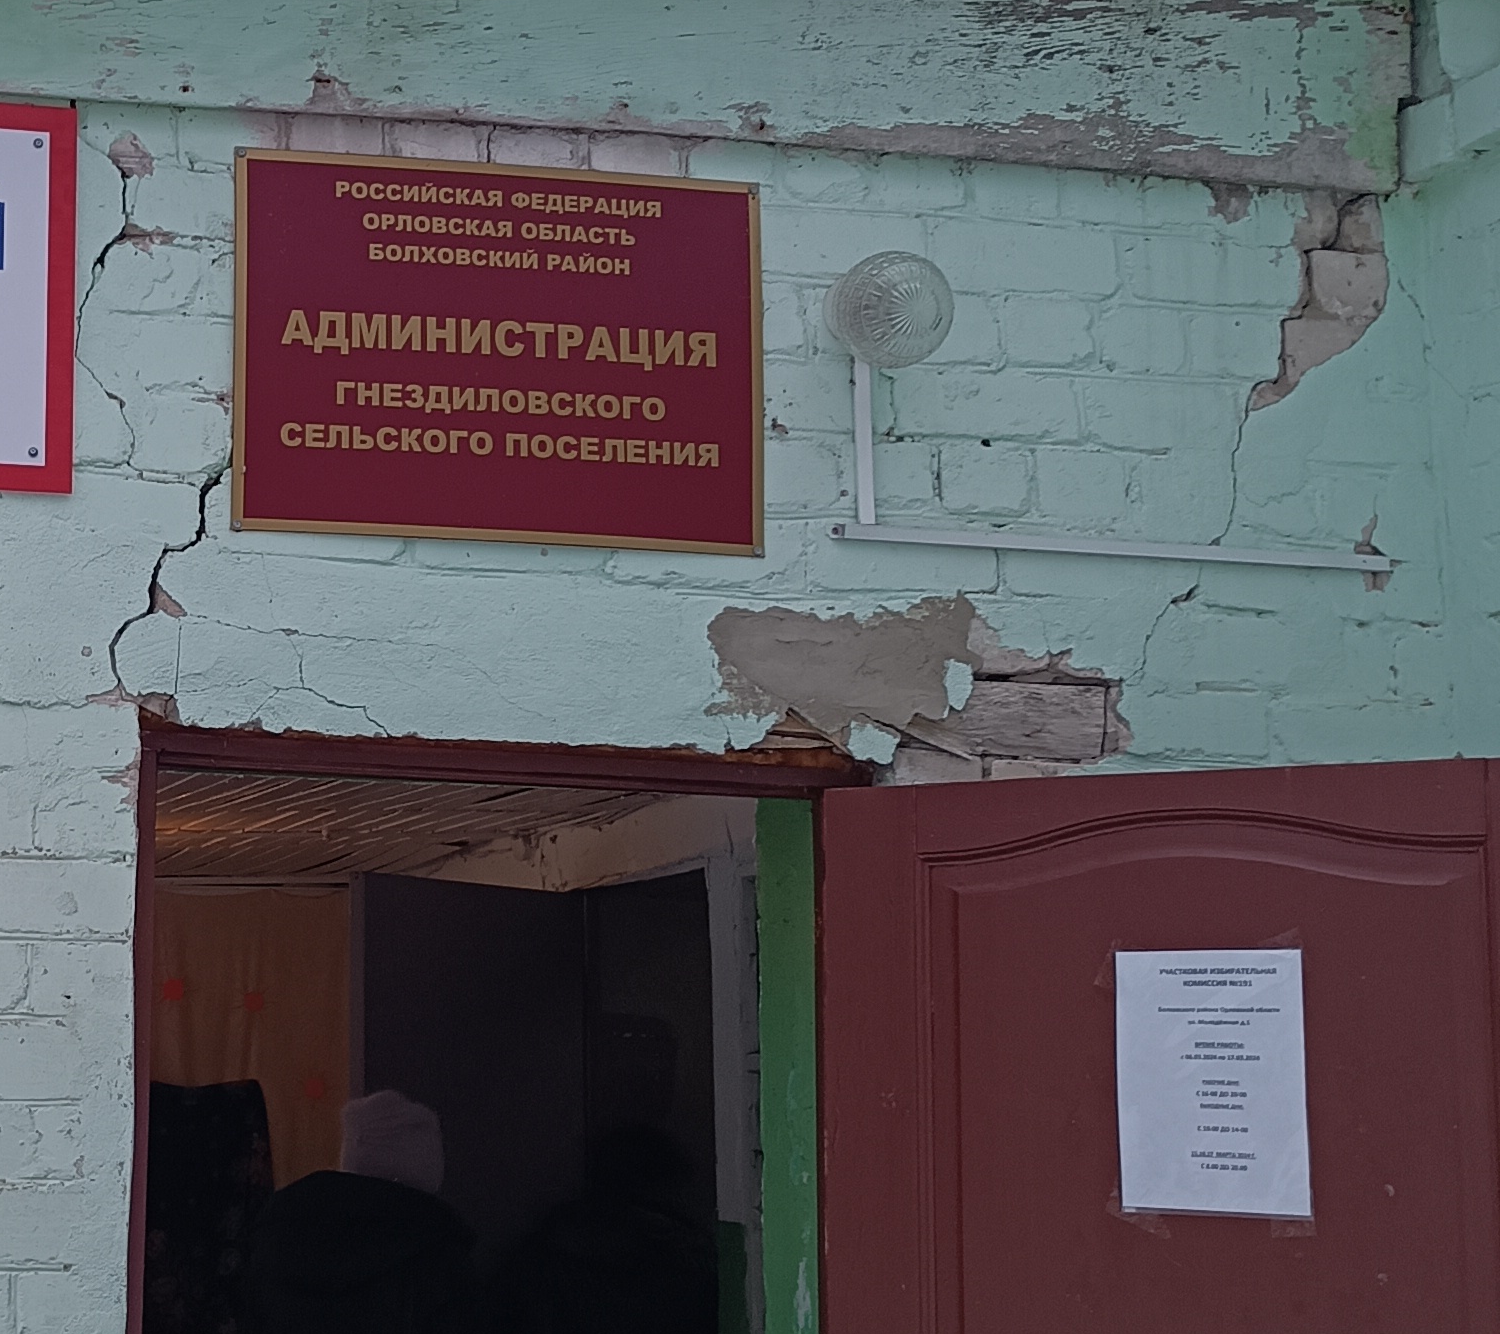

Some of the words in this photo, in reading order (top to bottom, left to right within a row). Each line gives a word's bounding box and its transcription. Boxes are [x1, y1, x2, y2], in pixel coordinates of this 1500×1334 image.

[334, 180, 503, 208] РОССИЙСКАЯ
[510, 191, 662, 219] ФЕДЕРАЦИЯ
[362, 212, 513, 238] ОРЛОВСКАЯ
[520, 222, 636, 247] ОБЛАСТЬ
[368, 242, 539, 271] БОЛХОВСКИЙ
[546, 252, 631, 276] РАЙОН
[281, 308, 718, 371] АДМИНИСТРАЦИЯ
[335, 380, 666, 422] ГНЕЗДИЛОВСКОГО
[280, 422, 494, 456] СЕЛЬСКОГО
[504, 432, 720, 468] ПОСЕЛЕНИЯ
